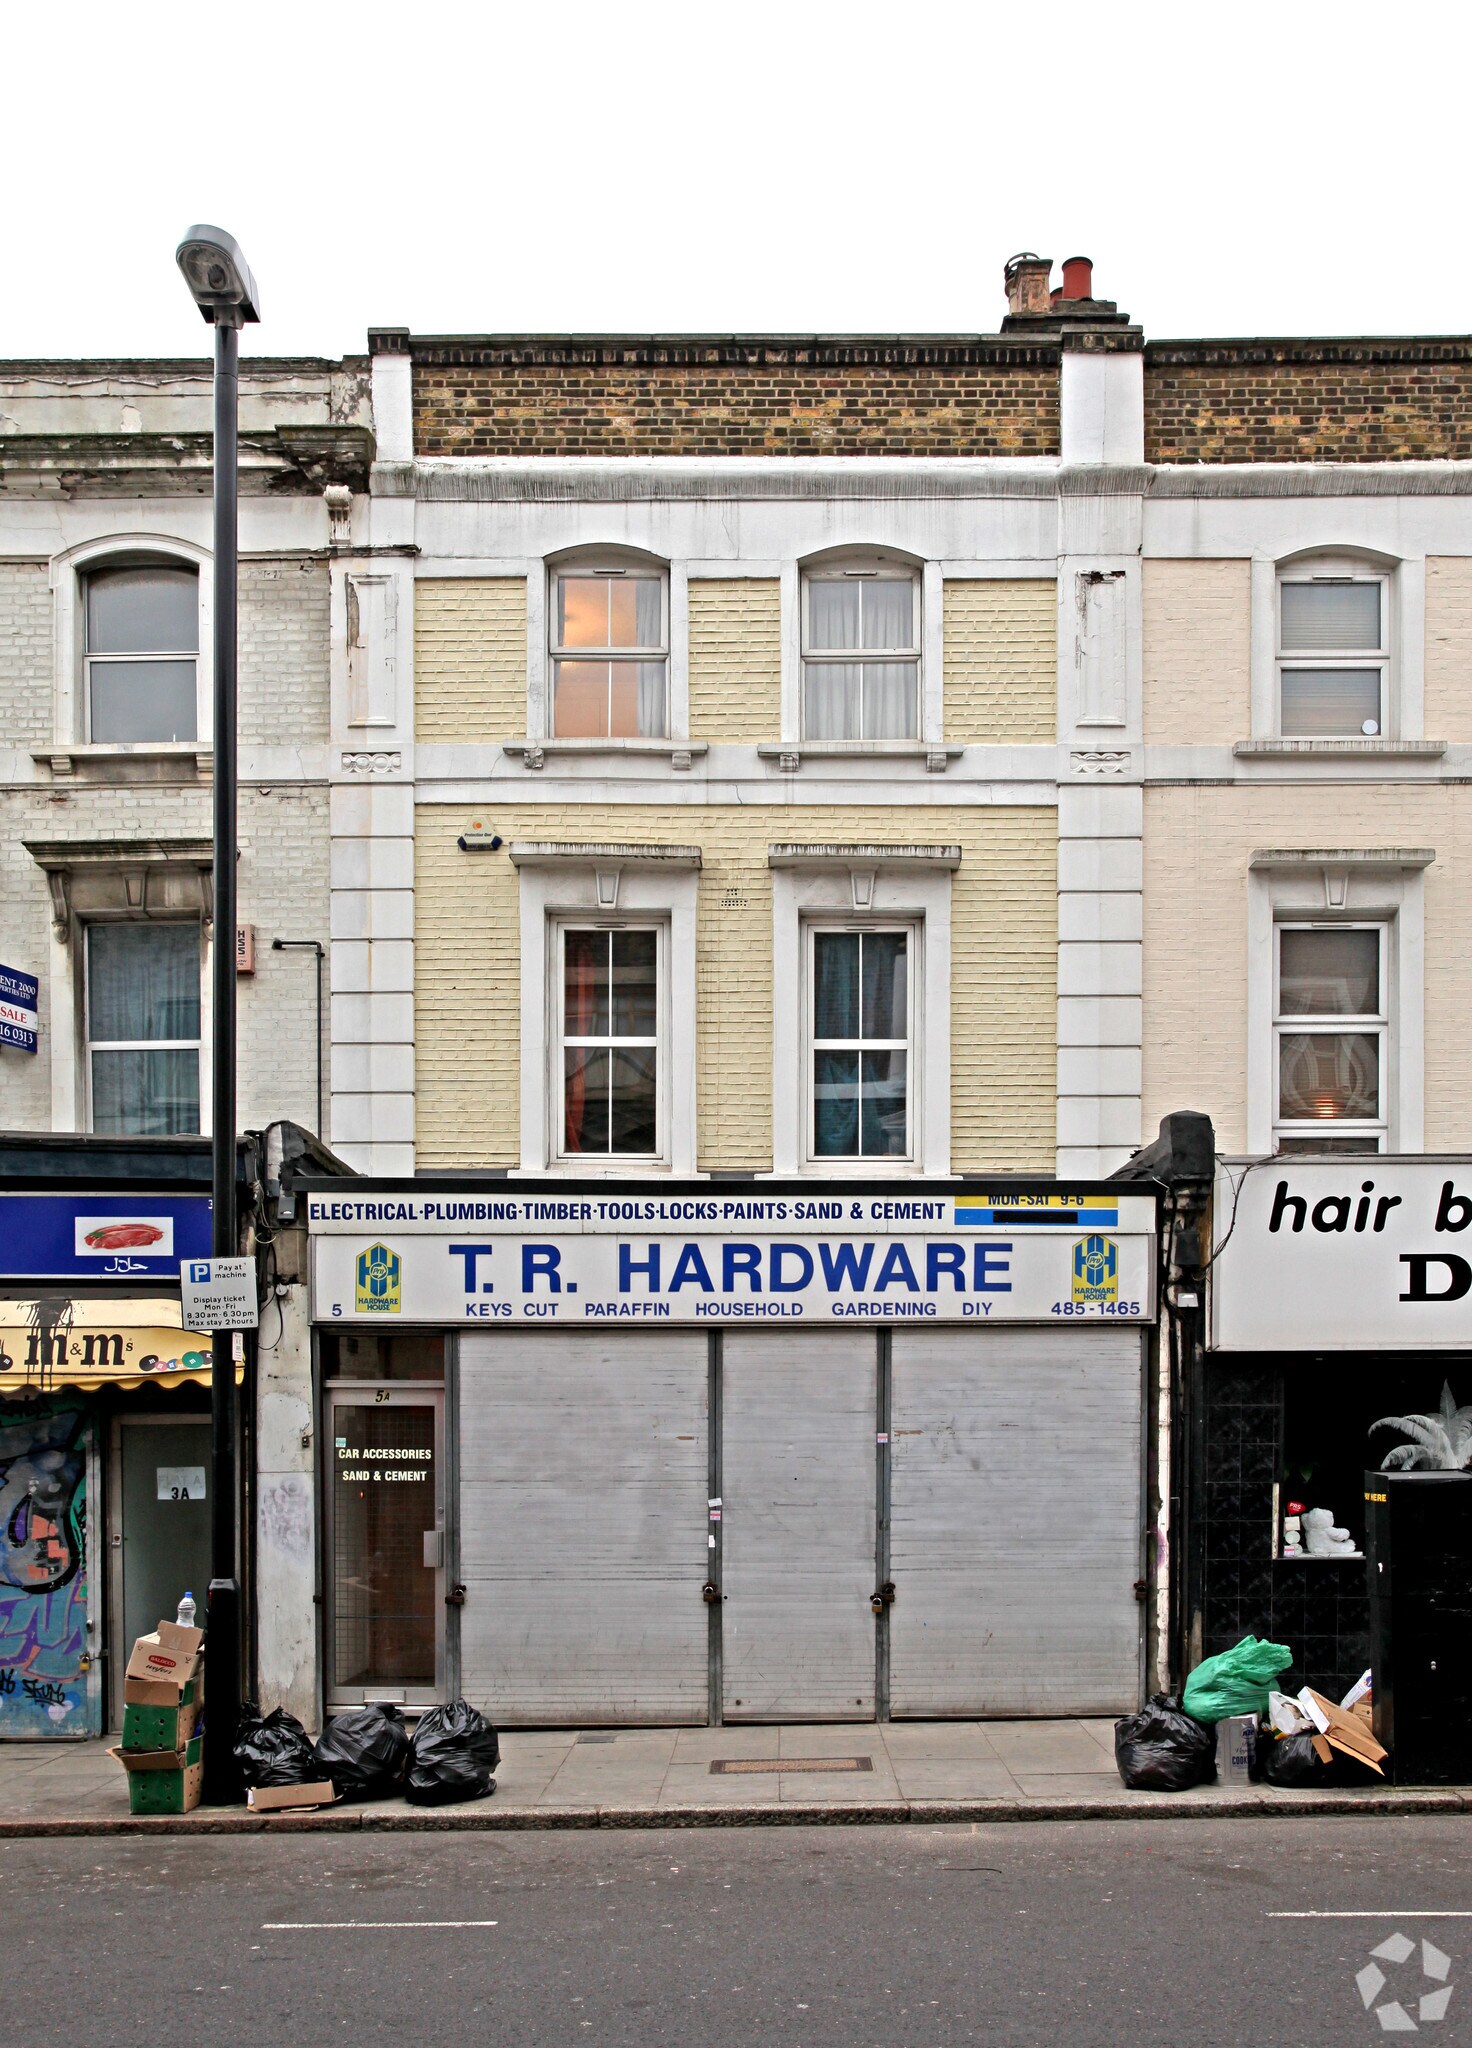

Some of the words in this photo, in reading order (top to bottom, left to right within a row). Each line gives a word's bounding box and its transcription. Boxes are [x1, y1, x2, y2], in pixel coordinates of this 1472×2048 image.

[19, 982, 36, 995] 2000
[0, 1006, 27, 1024] SALE
[12, 1028, 33, 1044] 0313
[310, 1203, 418, 1221] ELECTRICAL
[424, 1203, 518, 1221] PLUMBING
[523, 1203, 592, 1220] TIMBER
[599, 1203, 654, 1220] TOOLS
[660, 1203, 718, 1220] LOCKS
[723, 1203, 787, 1220] PAINTS
[795, 1203, 843, 1220] SAND
[850, 1203, 864, 1220] &
[871, 1203, 946, 1220] CEMENT
[1269, 1180, 1402, 1233] hair
[1434, 1180, 1472, 1233] b
[104, 1256, 149, 1273] حلال
[218, 1264, 233, 1272] Pay
[449, 1244, 494, 1293] T.
[521, 1244, 578, 1293] R.
[619, 1243, 1013, 1293] HARDWARE
[194, 1264, 208, 1282] P
[214, 1271, 247, 1279] machine
[1399, 1253, 1472, 1302] D
[193, 1296, 222, 1304] Display
[331, 1303, 343, 1317] 5
[367, 1303, 390, 1311] HOUSE
[466, 1303, 513, 1317] KEYS
[523, 1303, 559, 1317] CUT
[585, 1303, 670, 1317] PARAFFIN
[695, 1302, 804, 1316] HOUSEHOLD
[831, 1302, 937, 1316] GARDENING
[962, 1302, 993, 1316] DIY
[375, 1390, 390, 1402] 5A
[338, 1449, 360, 1459] CAR
[362, 1448, 432, 1460] ACCESSORIES
[342, 1471, 370, 1481] SAND
[373, 1471, 381, 1481] &
[384, 1471, 427, 1481] CEMENT
[171, 1487, 190, 1500] 3A
[1370, 1493, 1387, 1503] HERE
